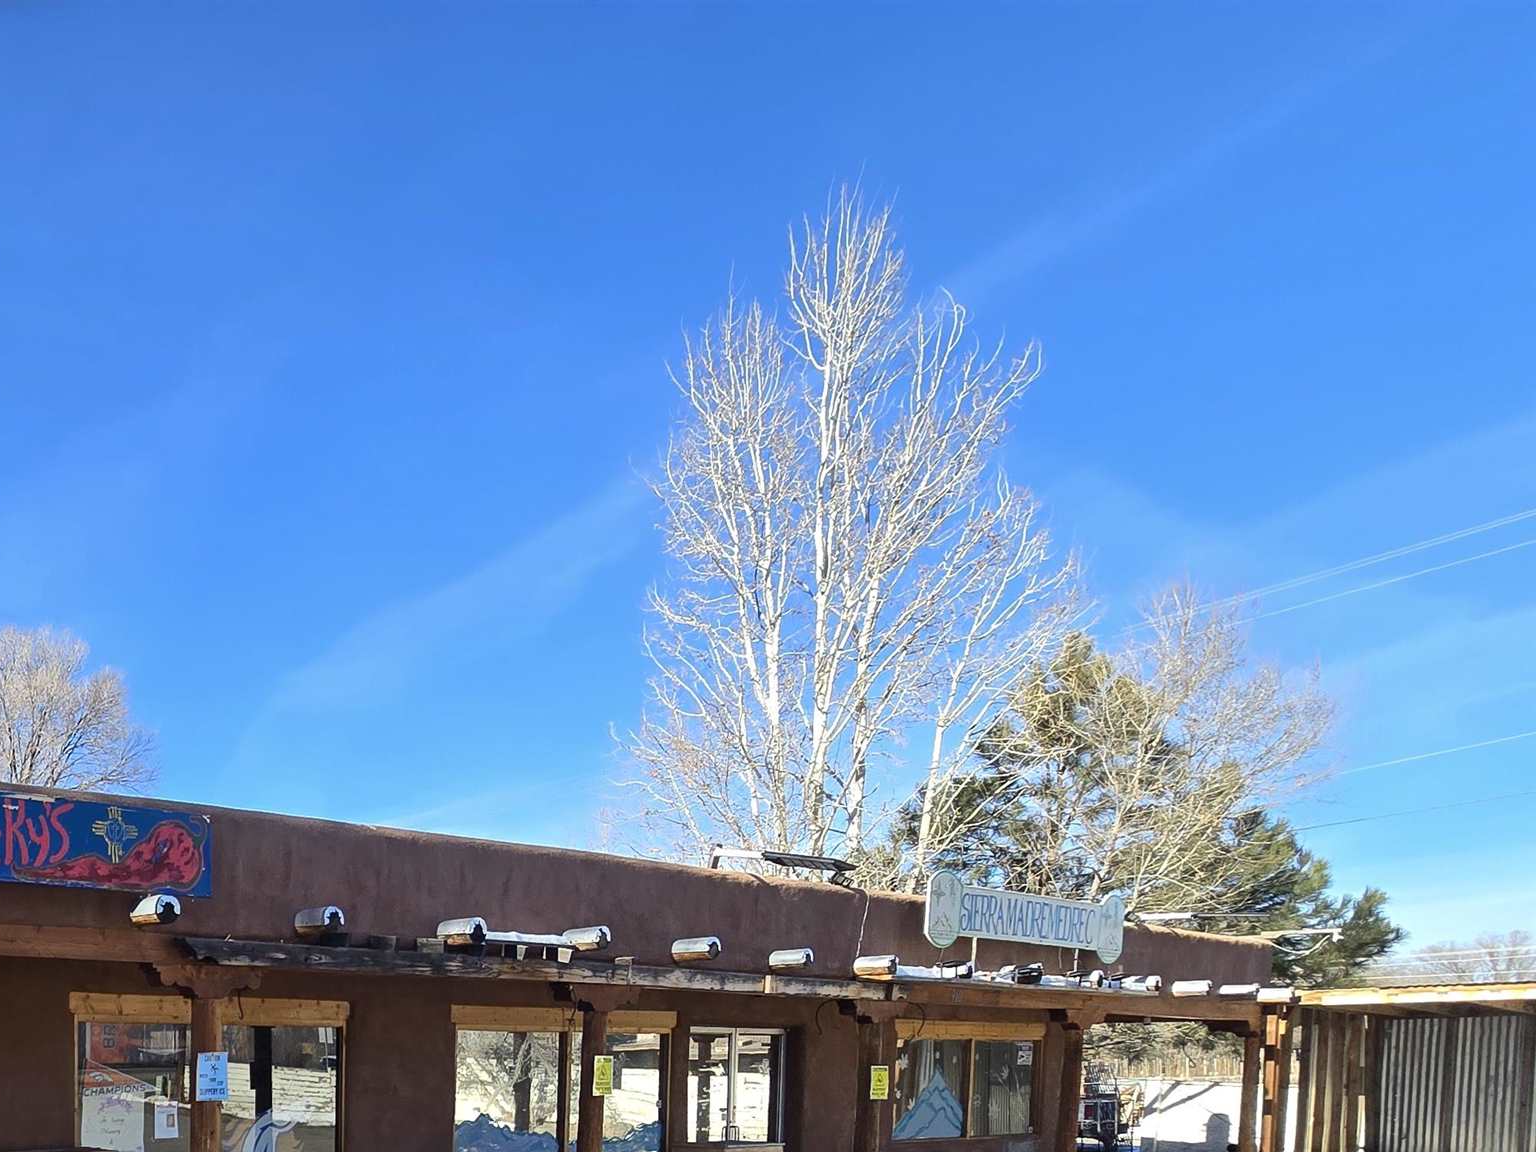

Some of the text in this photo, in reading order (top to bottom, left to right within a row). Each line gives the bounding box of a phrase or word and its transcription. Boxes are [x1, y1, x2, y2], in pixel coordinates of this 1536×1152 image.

[960, 892, 1006, 936] SIERRA
[1006, 898, 1048, 940] MADRE
[83, 1083, 146, 1098] CHAMPIONS
